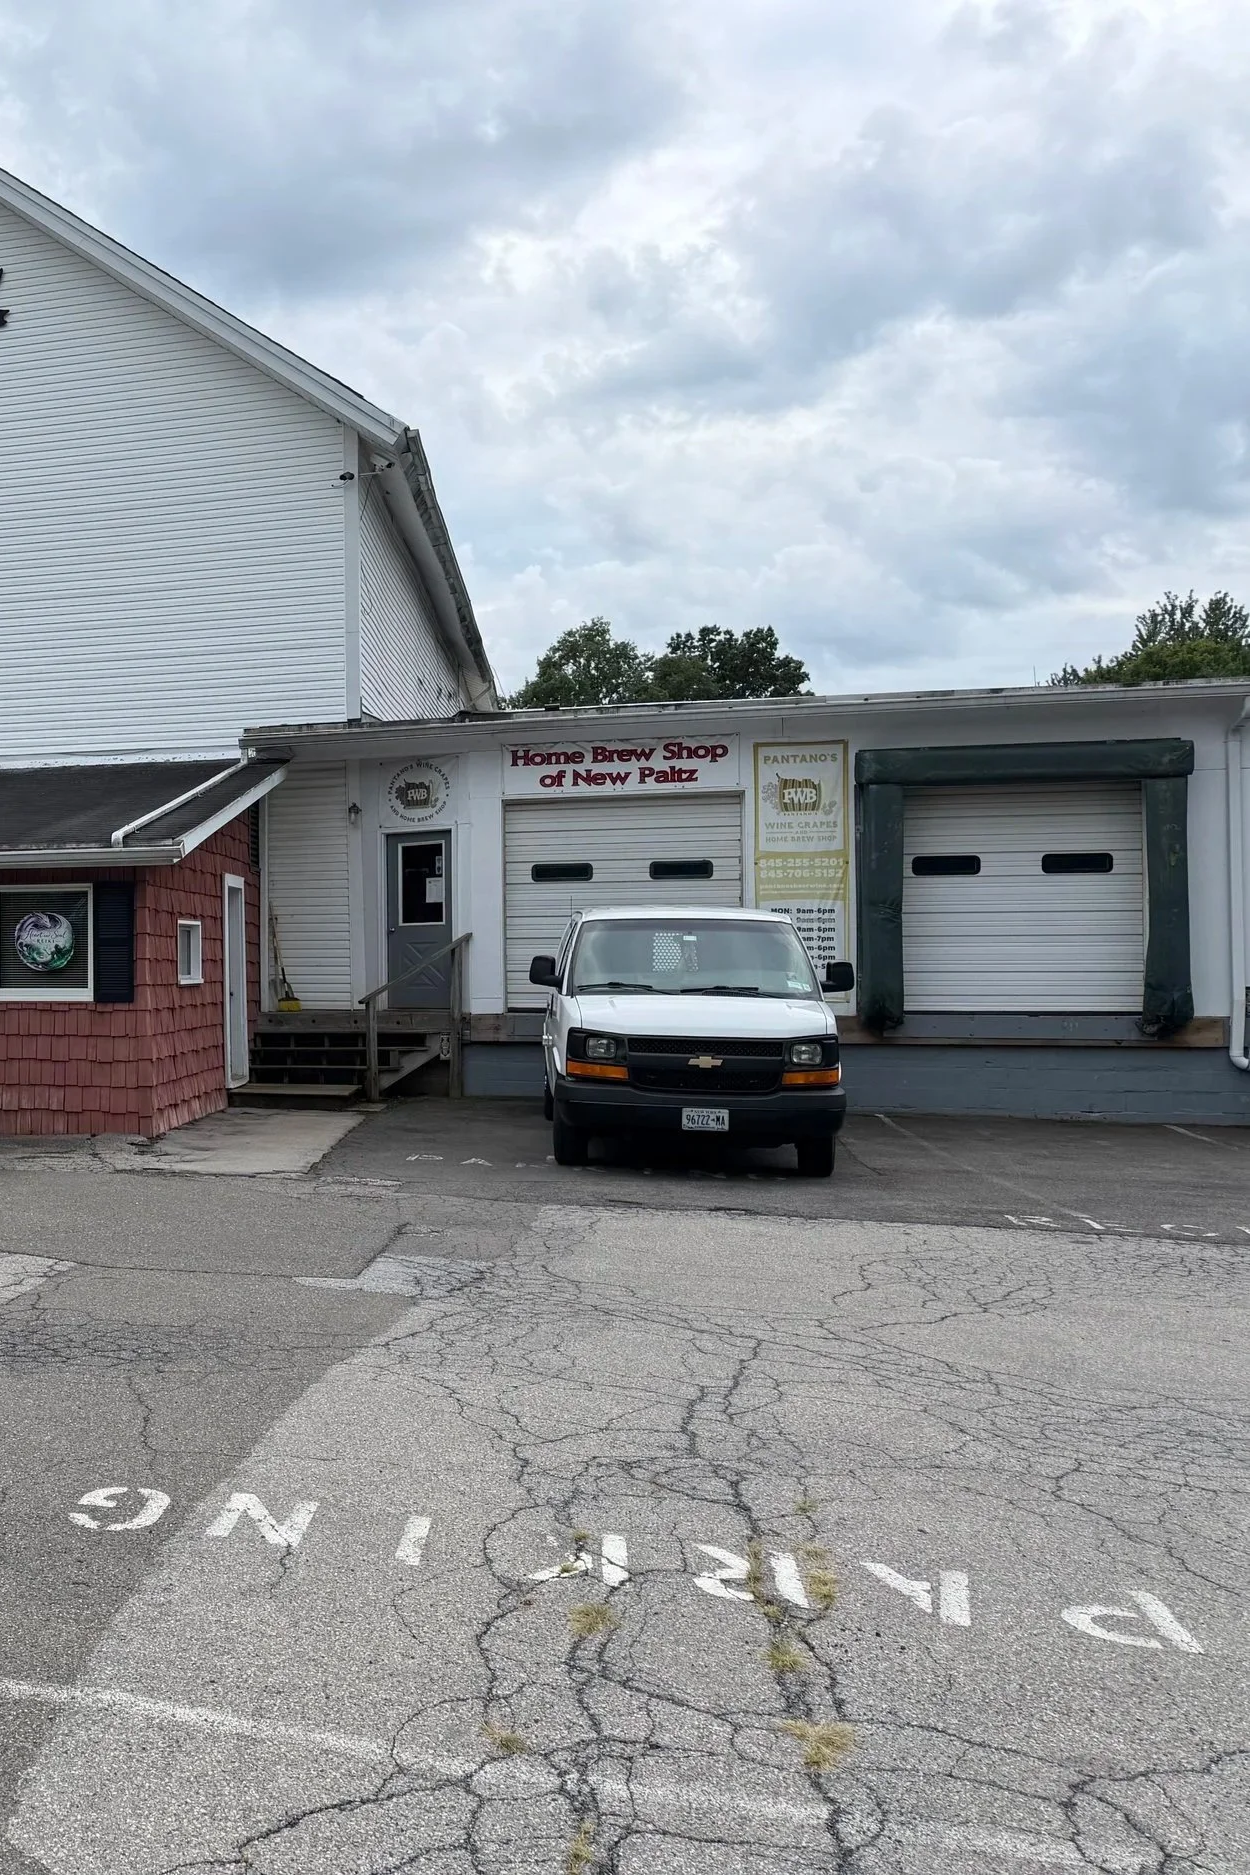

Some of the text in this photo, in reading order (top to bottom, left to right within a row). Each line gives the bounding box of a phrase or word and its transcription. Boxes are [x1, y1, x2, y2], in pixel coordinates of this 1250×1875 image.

[510, 742, 729, 767] Home Brew Shop
[763, 753, 838, 765] PANTANO'S
[388, 763, 414, 795] PANTANO'S
[415, 761, 434, 770] WINE
[539, 766, 699, 788] of New Paltz
[407, 788, 428, 800] PWB
[782, 787, 817, 804] PWB
[390, 800, 447, 823] AND HOME BREW SHOP
[764, 821, 794, 830] WINE
[796, 907, 836, 915] 9am-6pm
[801, 935, 835, 943] am-7pm
